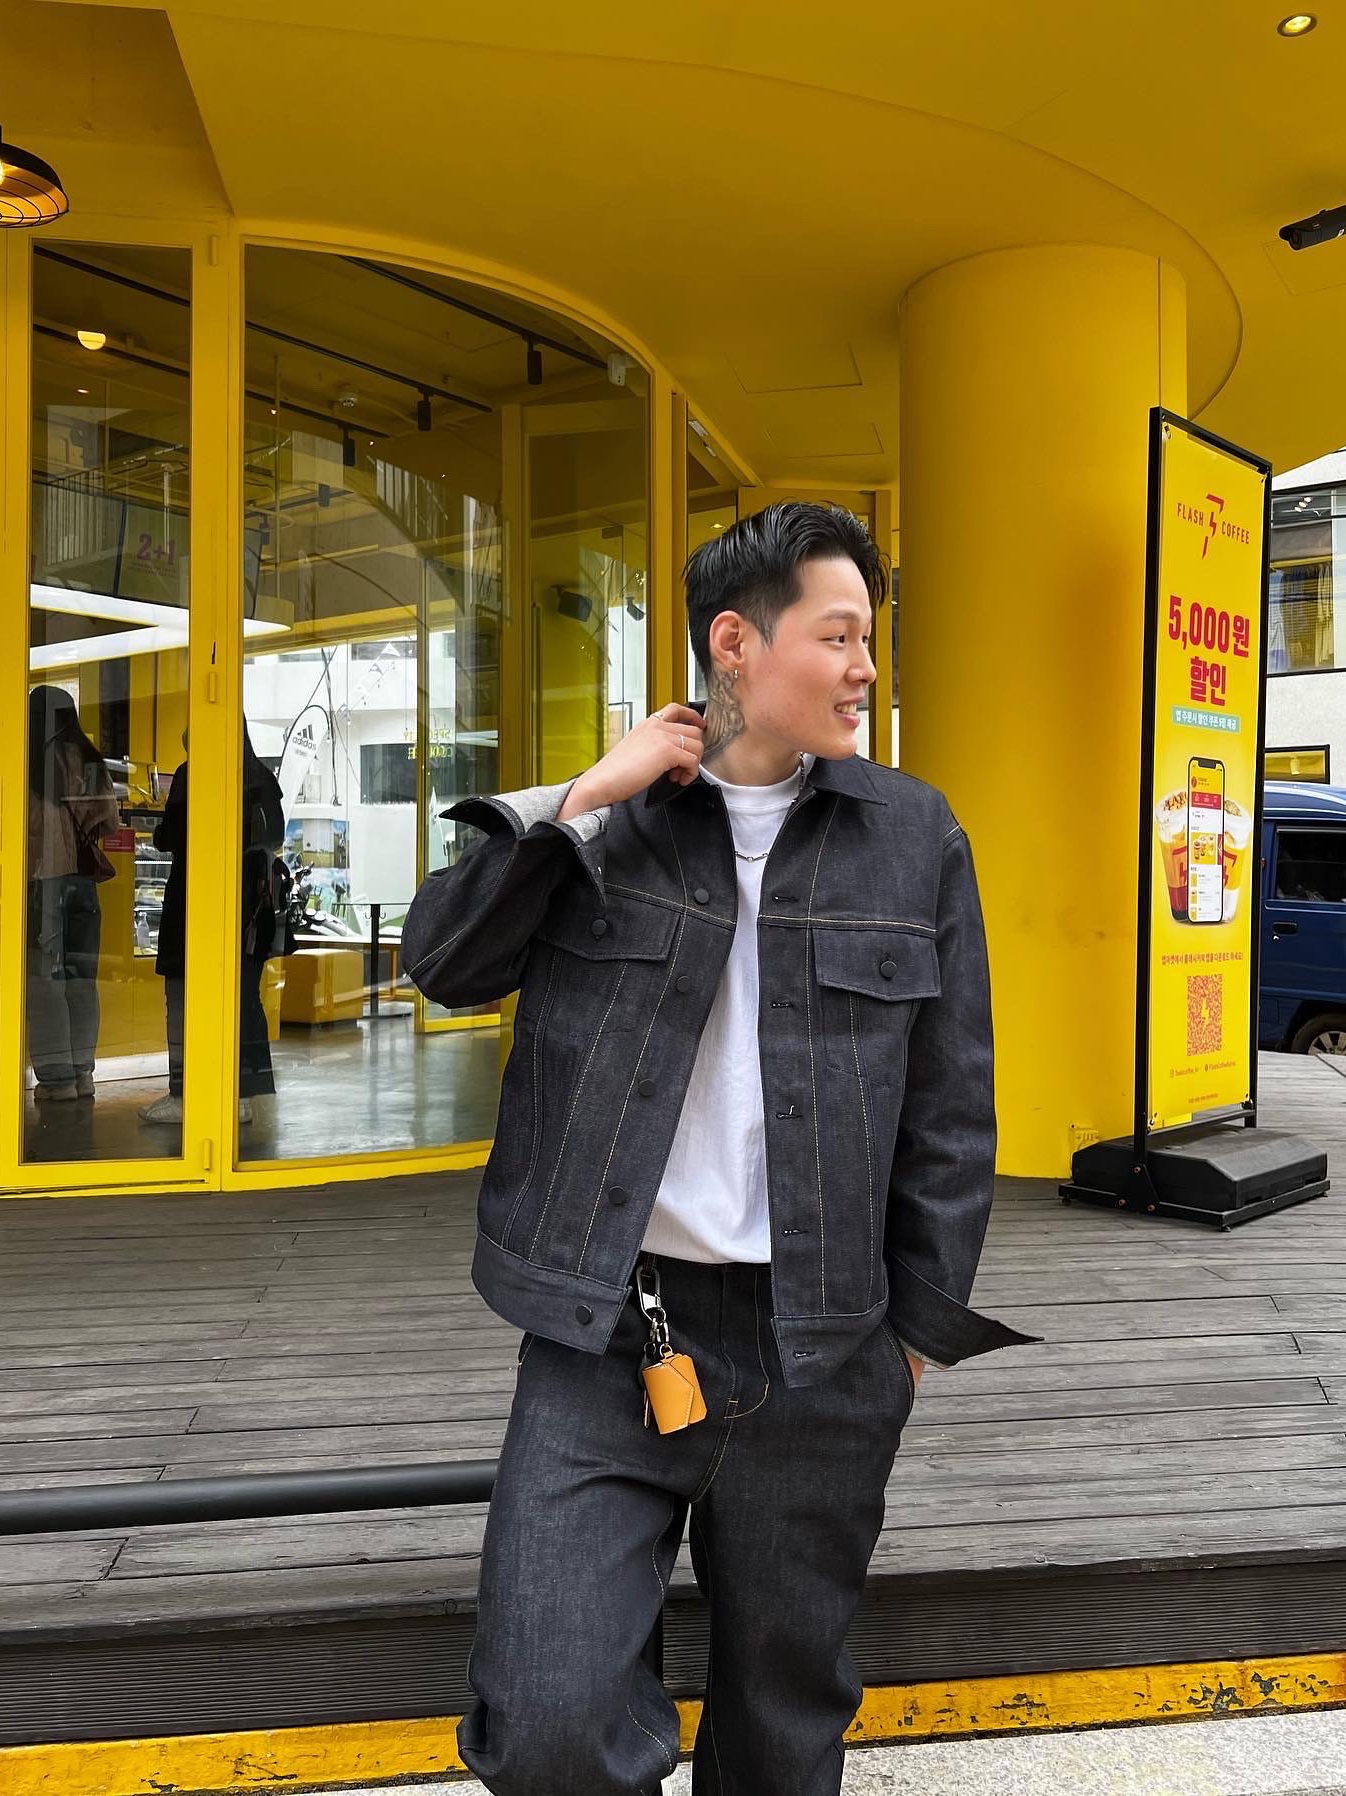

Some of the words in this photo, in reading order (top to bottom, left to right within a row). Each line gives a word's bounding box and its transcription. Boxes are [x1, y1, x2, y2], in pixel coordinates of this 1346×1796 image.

[1177, 502, 1204, 527] FLASH
[1221, 520, 1250, 545] COFFEE
[1168, 594, 1250, 659] 5,000원
[1190, 655, 1227, 707] 할인
[292, 735, 317, 751] adidas
